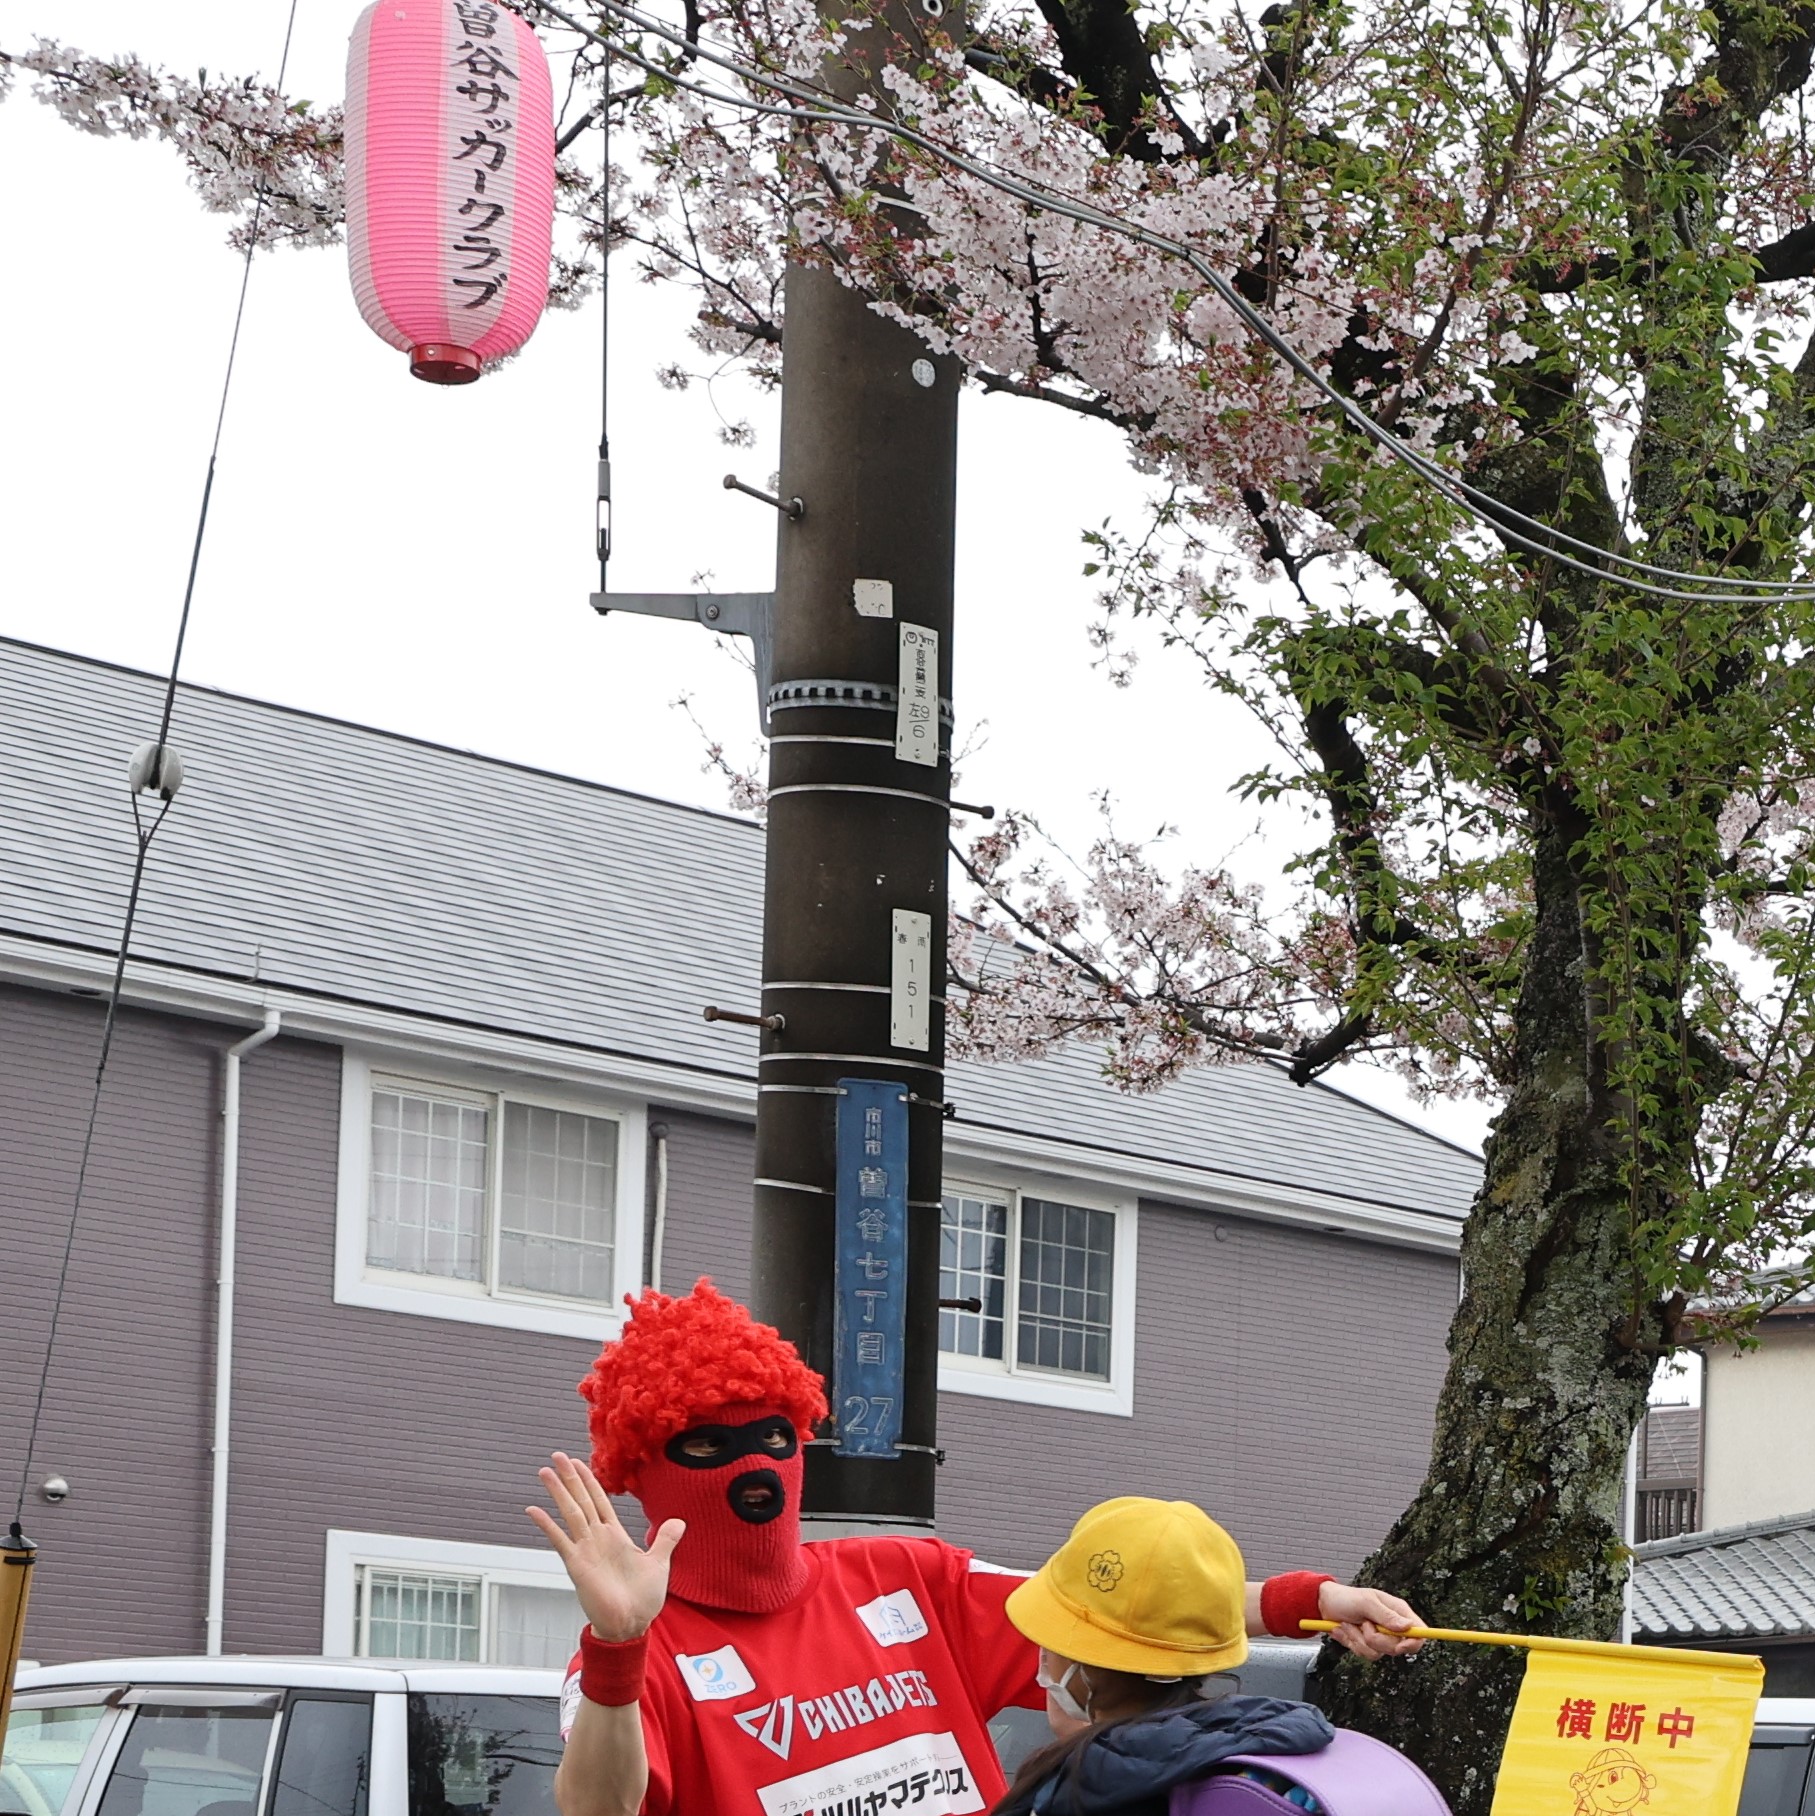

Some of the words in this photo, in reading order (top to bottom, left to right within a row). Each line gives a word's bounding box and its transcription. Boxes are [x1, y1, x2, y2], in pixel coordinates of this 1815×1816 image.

[865, 1107, 882, 1156] 市川市
[856, 1167, 889, 1366] 曽谷七丁目
[844, 1395, 895, 1436] 27
[705, 1679, 738, 1694] ZERO
[798, 1669, 938, 1740] CHIBAJETS
[1556, 1697, 1695, 1749] 横断中
